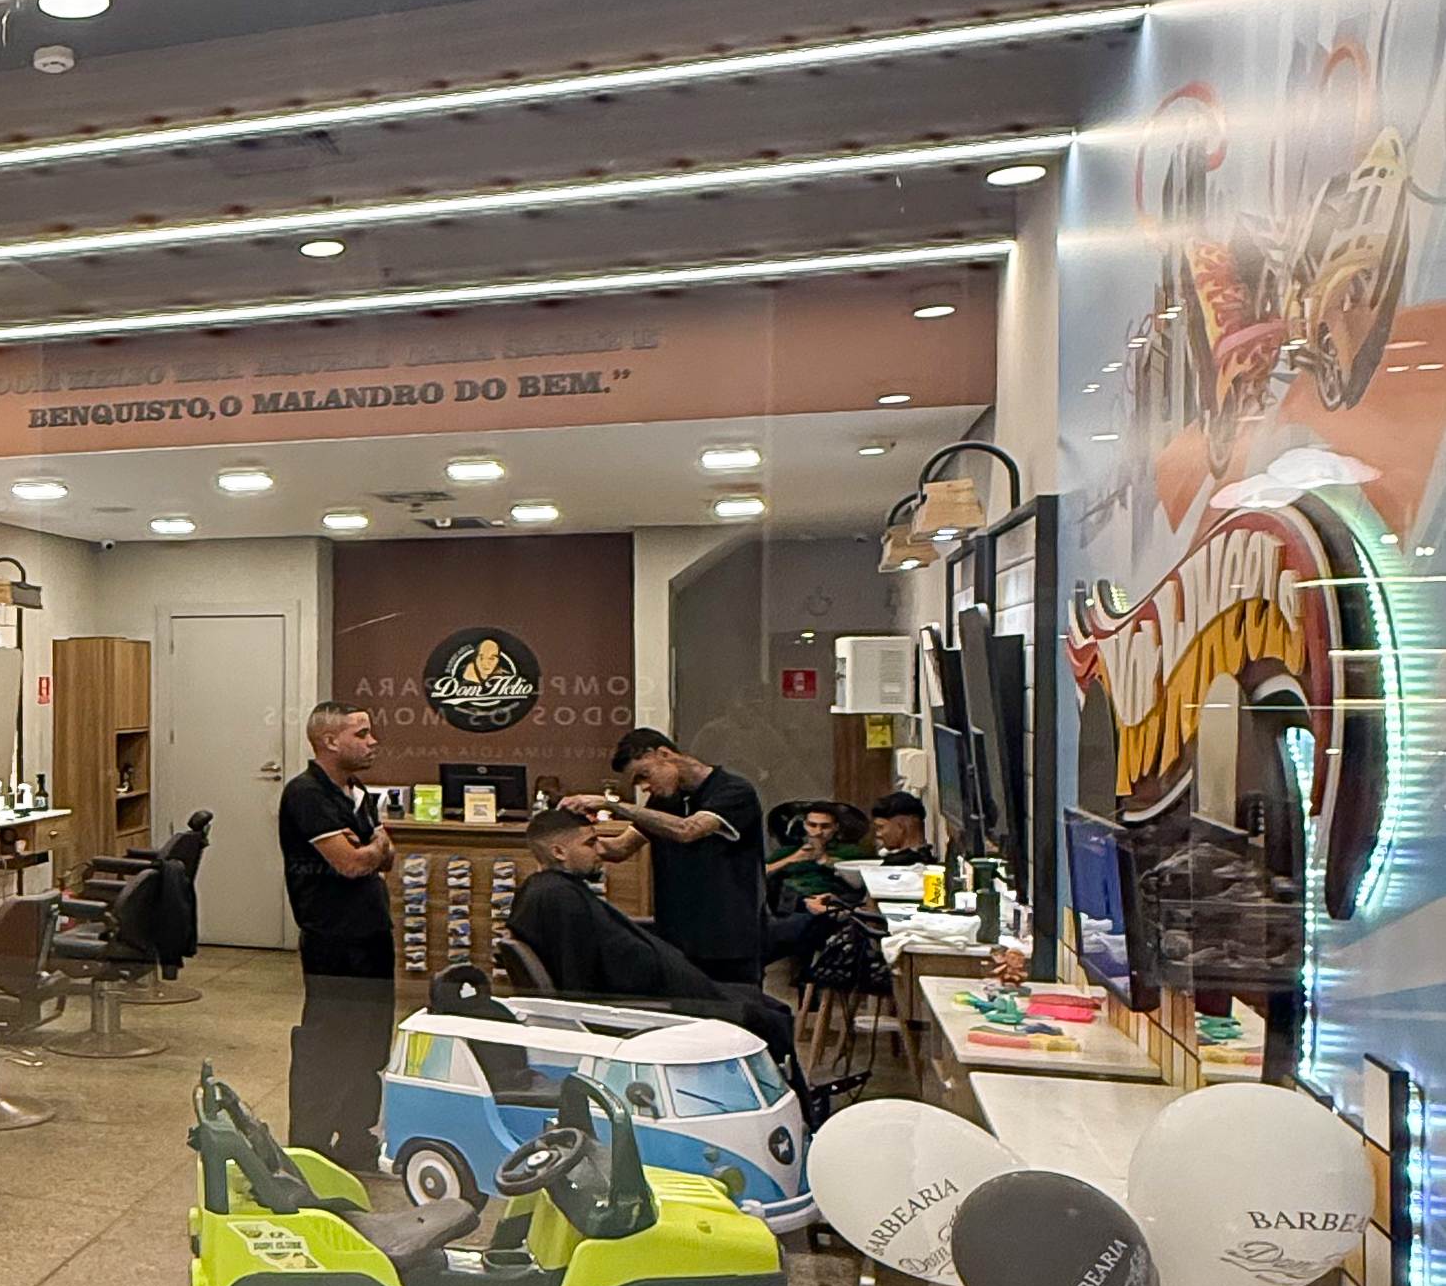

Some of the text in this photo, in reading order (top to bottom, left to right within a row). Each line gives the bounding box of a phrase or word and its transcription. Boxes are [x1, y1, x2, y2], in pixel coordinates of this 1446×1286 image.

[219, 395, 243, 417] O
[252, 380, 445, 415] MALANDRO
[454, 377, 507, 402] DO
